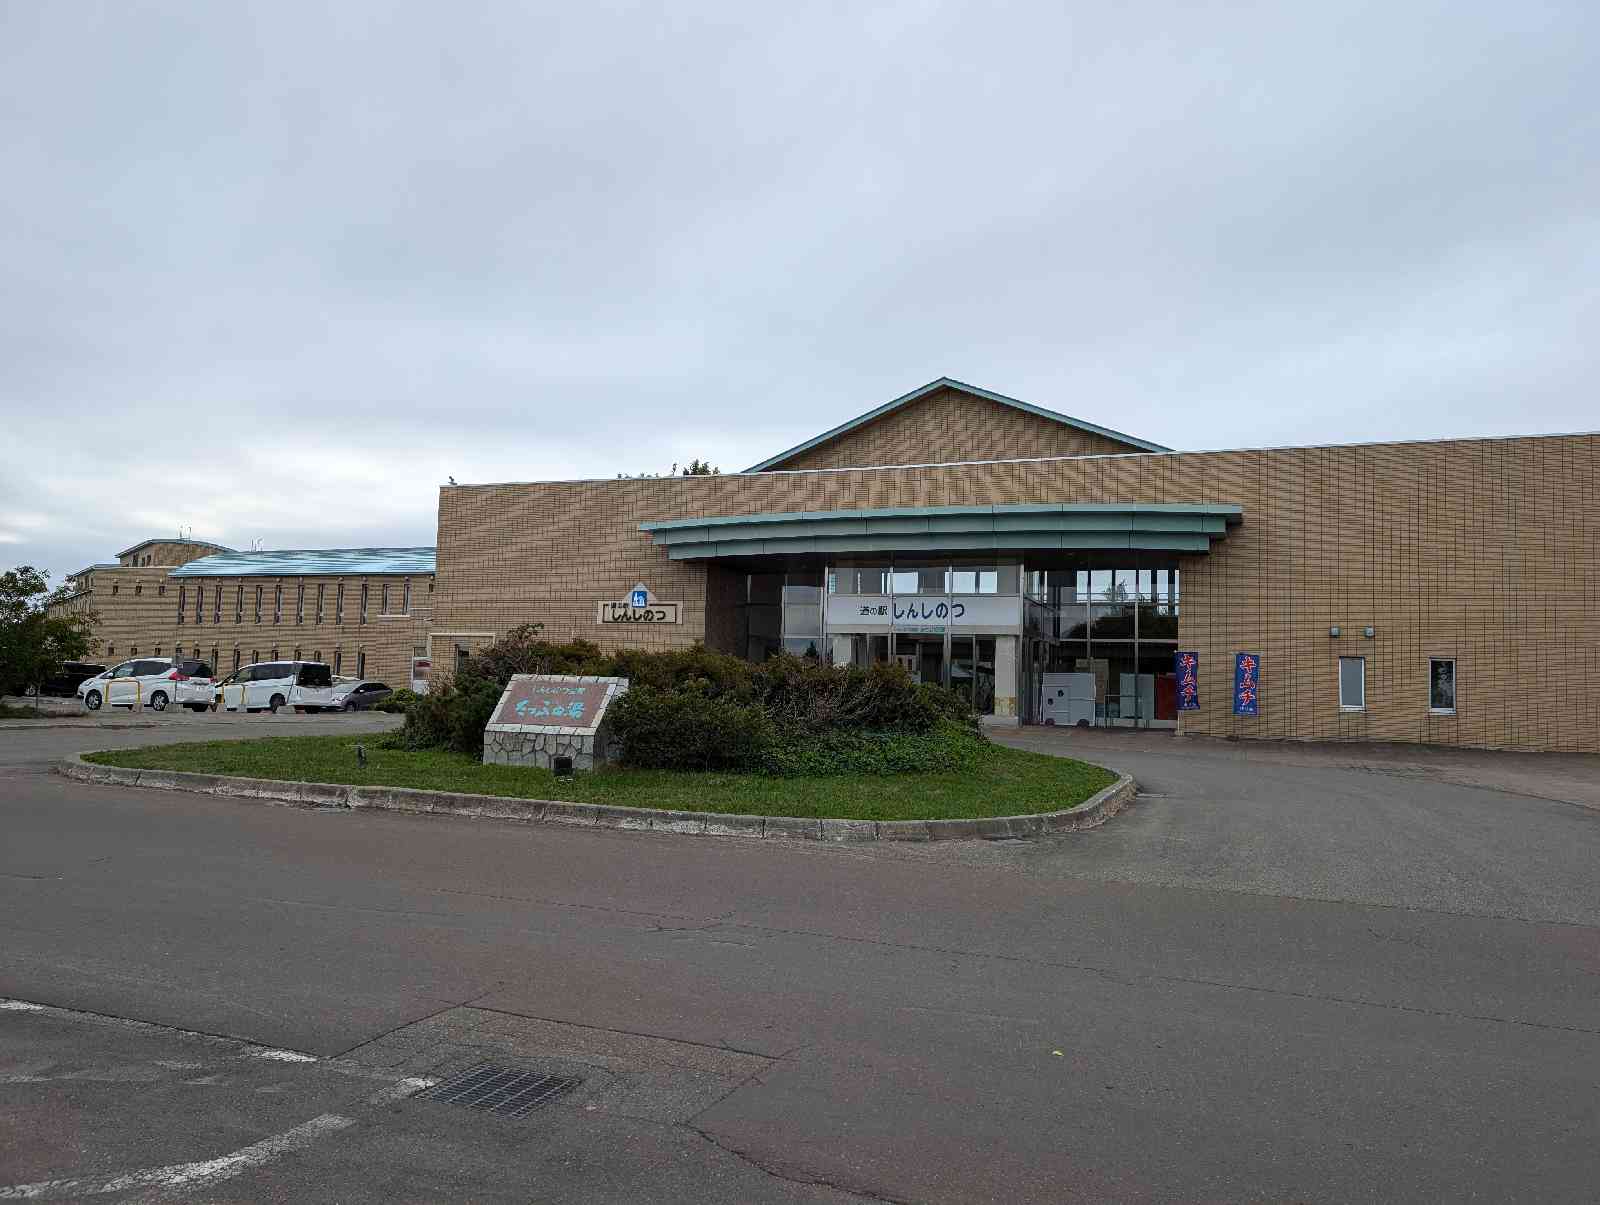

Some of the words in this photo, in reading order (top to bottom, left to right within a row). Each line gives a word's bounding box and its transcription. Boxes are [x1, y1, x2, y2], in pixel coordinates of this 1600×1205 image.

[611, 609, 667, 621] しんしのつ
[893, 602, 965, 620] しんしのつ
